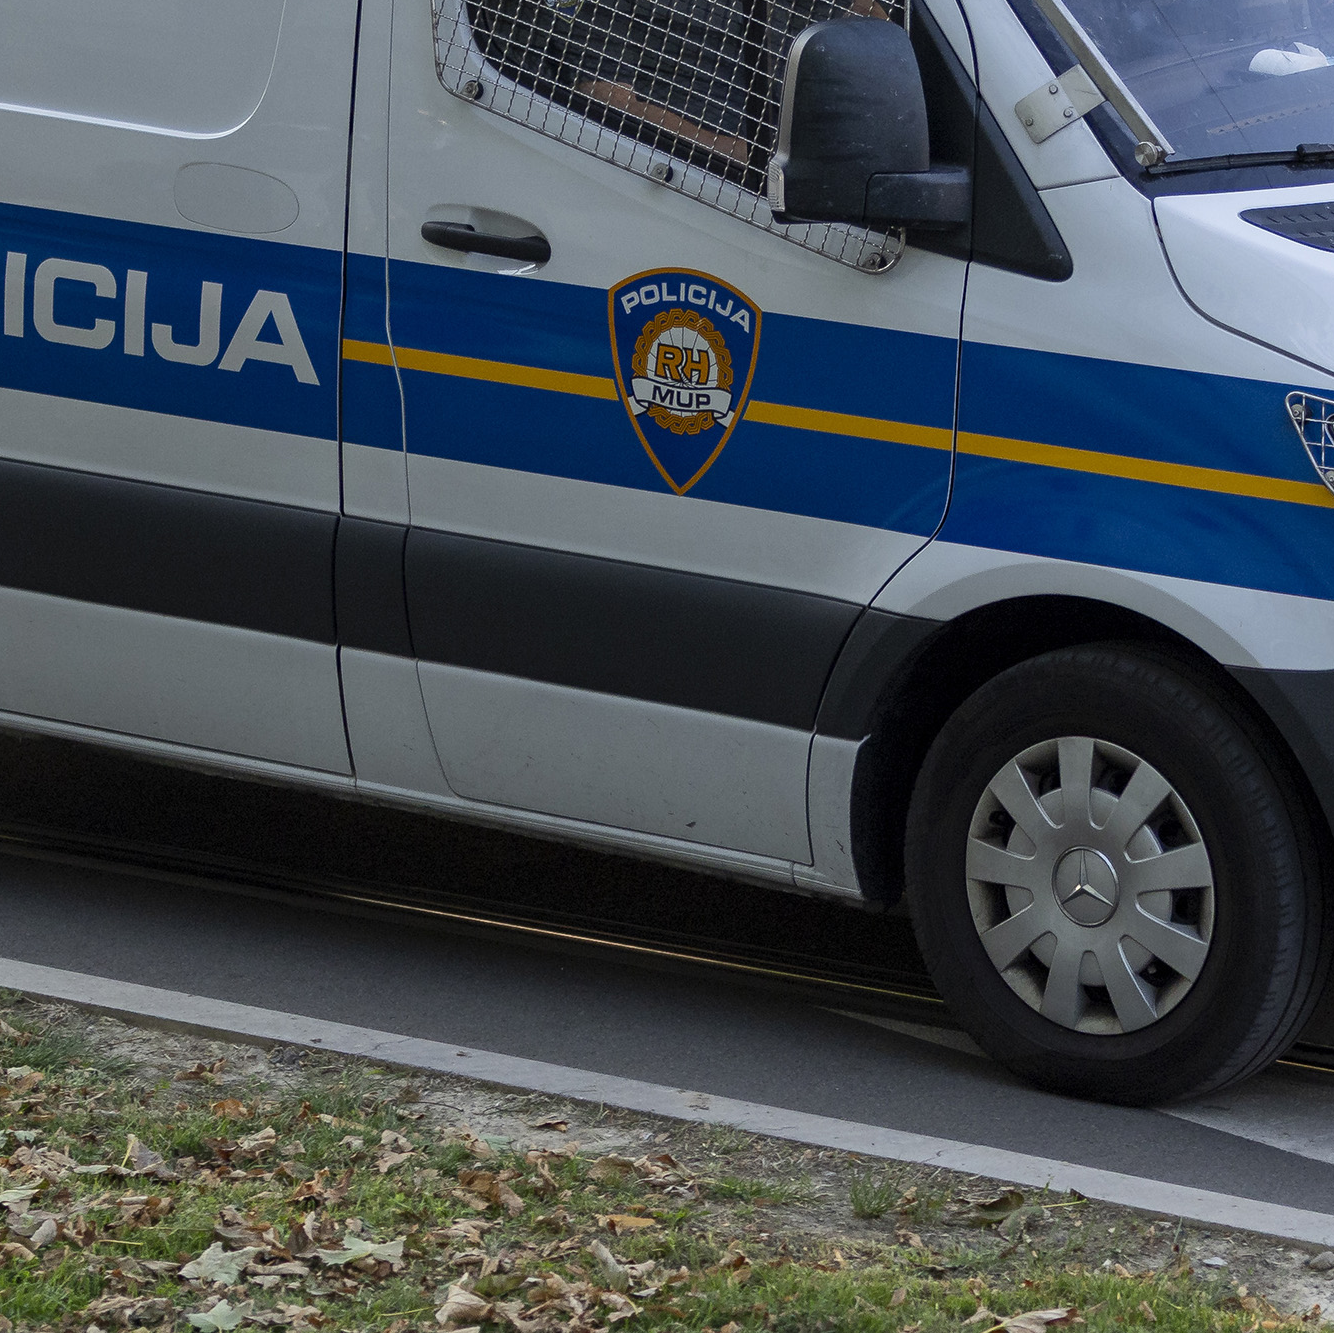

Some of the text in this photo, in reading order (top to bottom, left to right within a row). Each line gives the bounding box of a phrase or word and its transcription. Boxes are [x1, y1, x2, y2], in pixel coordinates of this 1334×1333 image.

[620, 282, 750, 334] POLICIJA
[654, 343, 710, 386] RH
[651, 385, 711, 409] MUP
